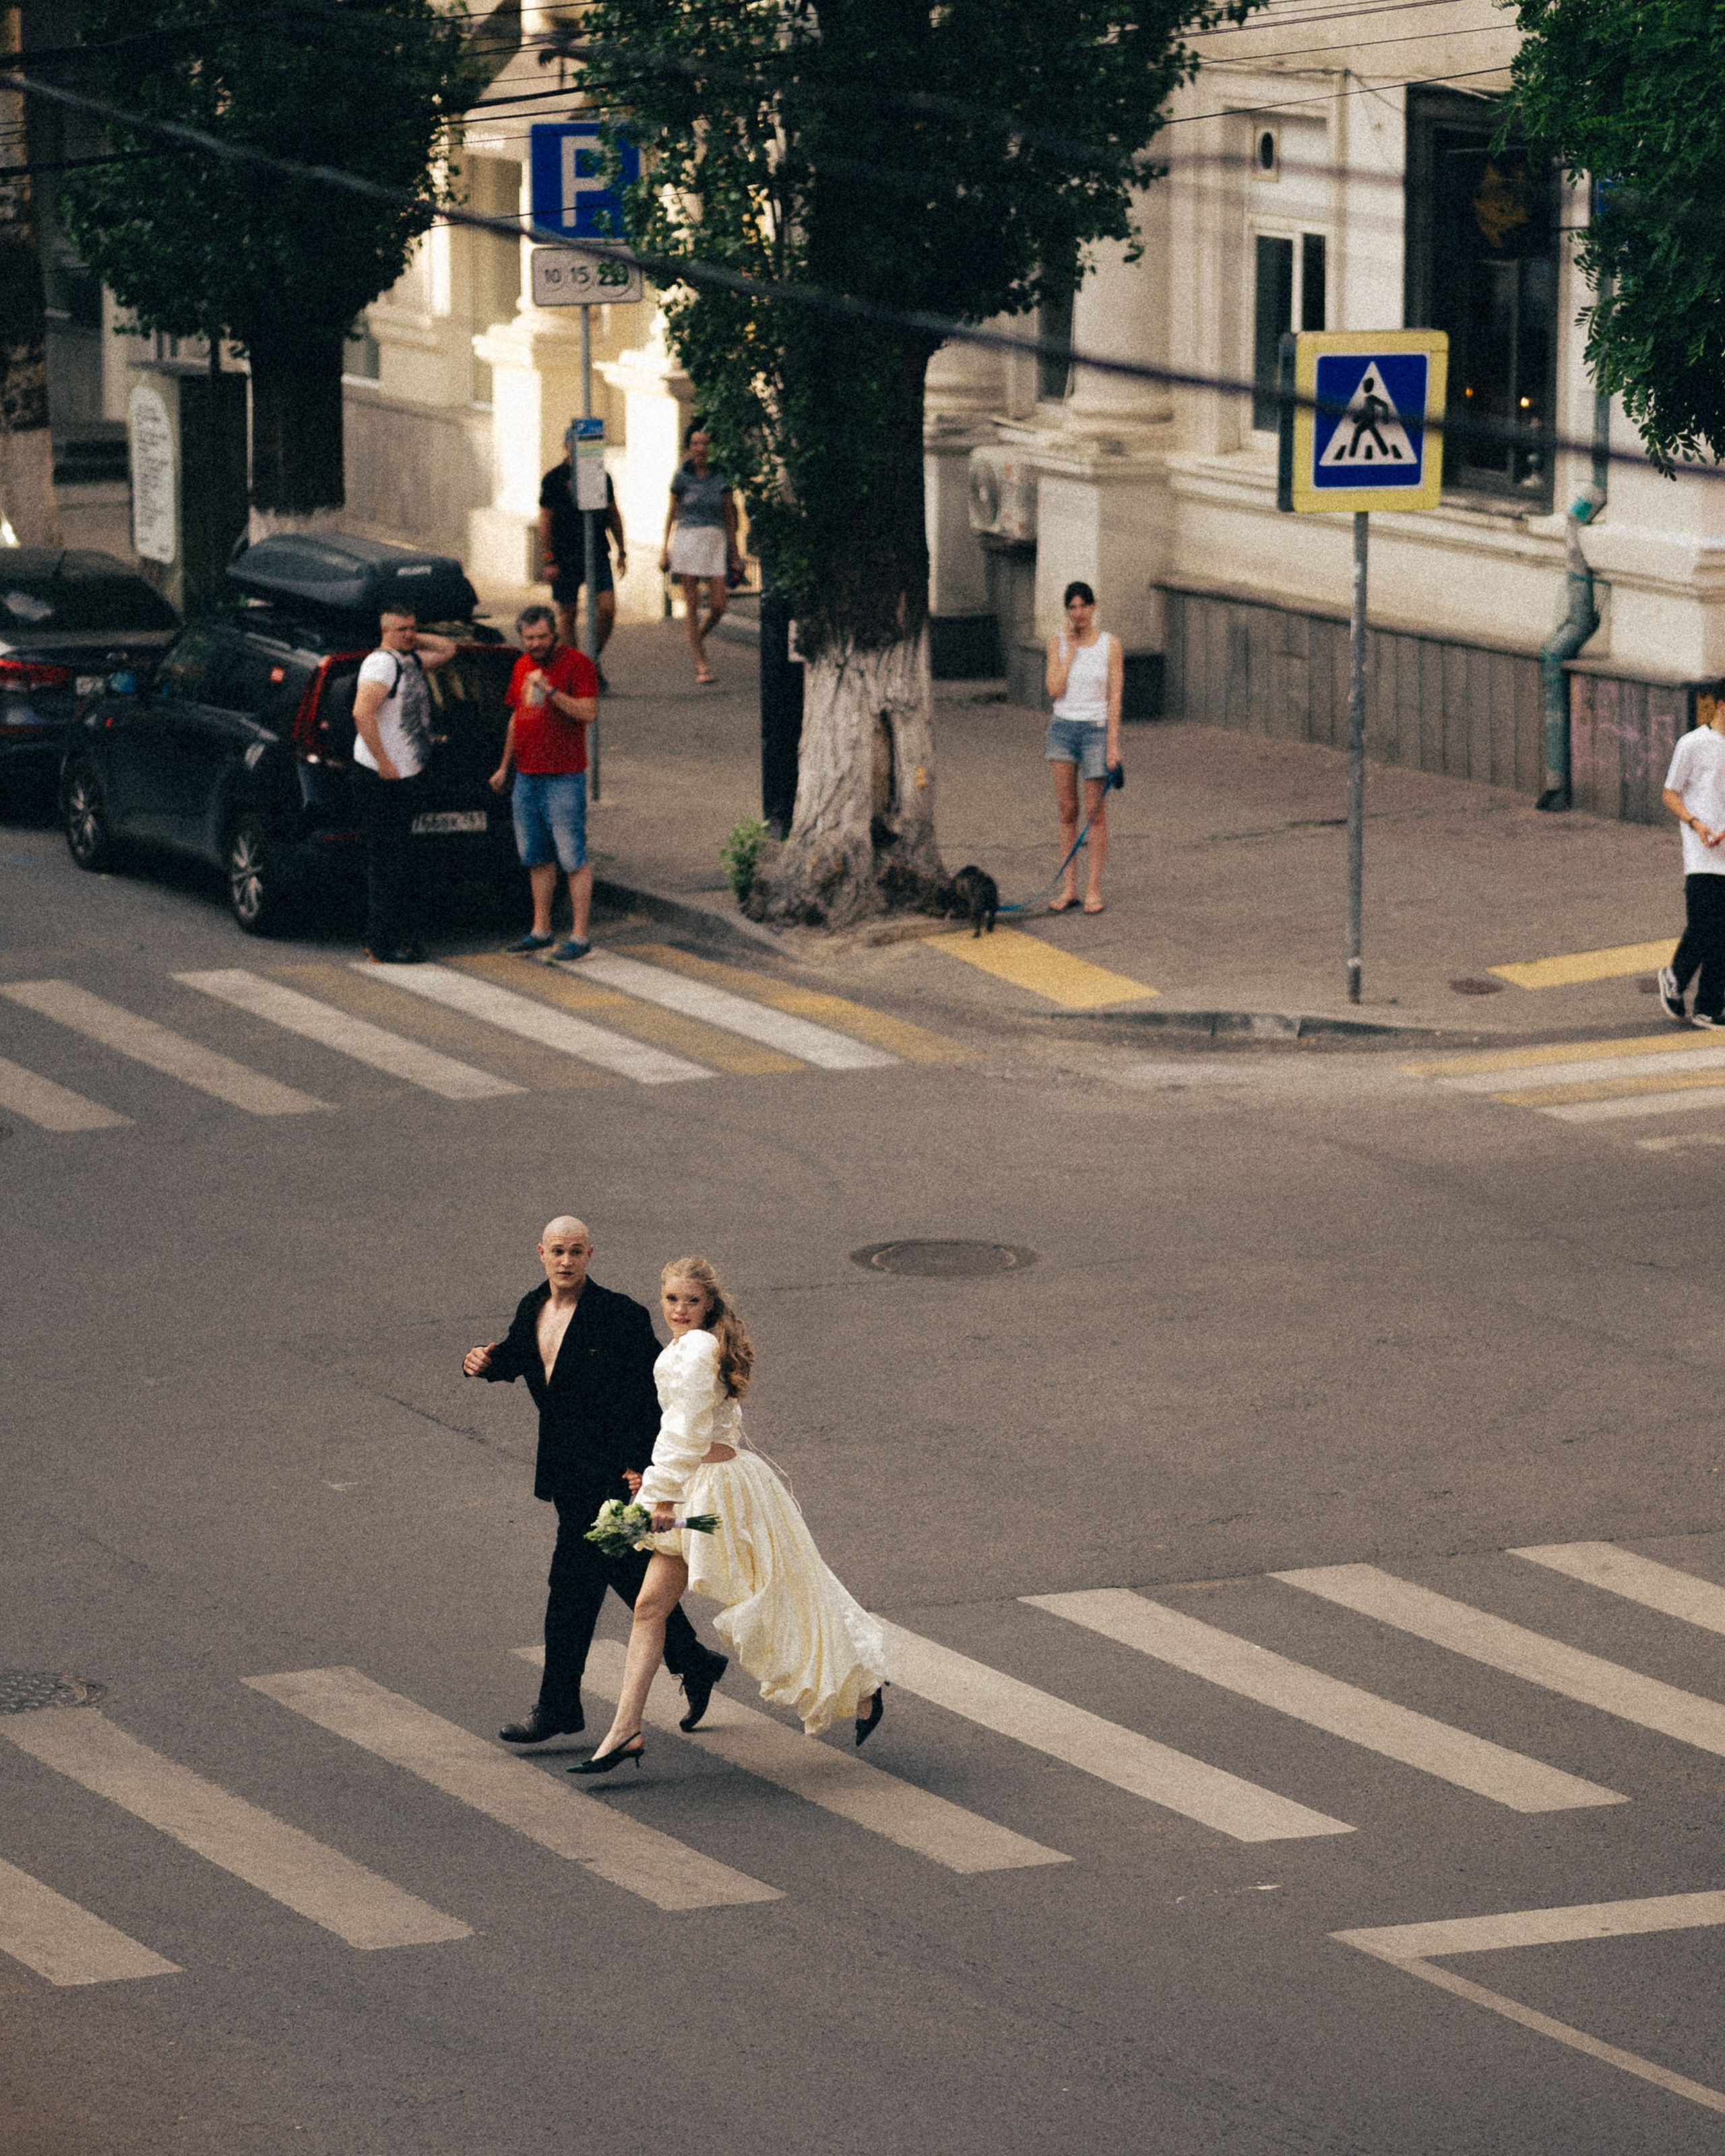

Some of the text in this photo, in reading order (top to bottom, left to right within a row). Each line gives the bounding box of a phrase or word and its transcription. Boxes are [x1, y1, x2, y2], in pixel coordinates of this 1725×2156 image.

[561, 135, 621, 227] P
[544, 268, 561, 284] 10
[570, 265, 590, 284] 15
